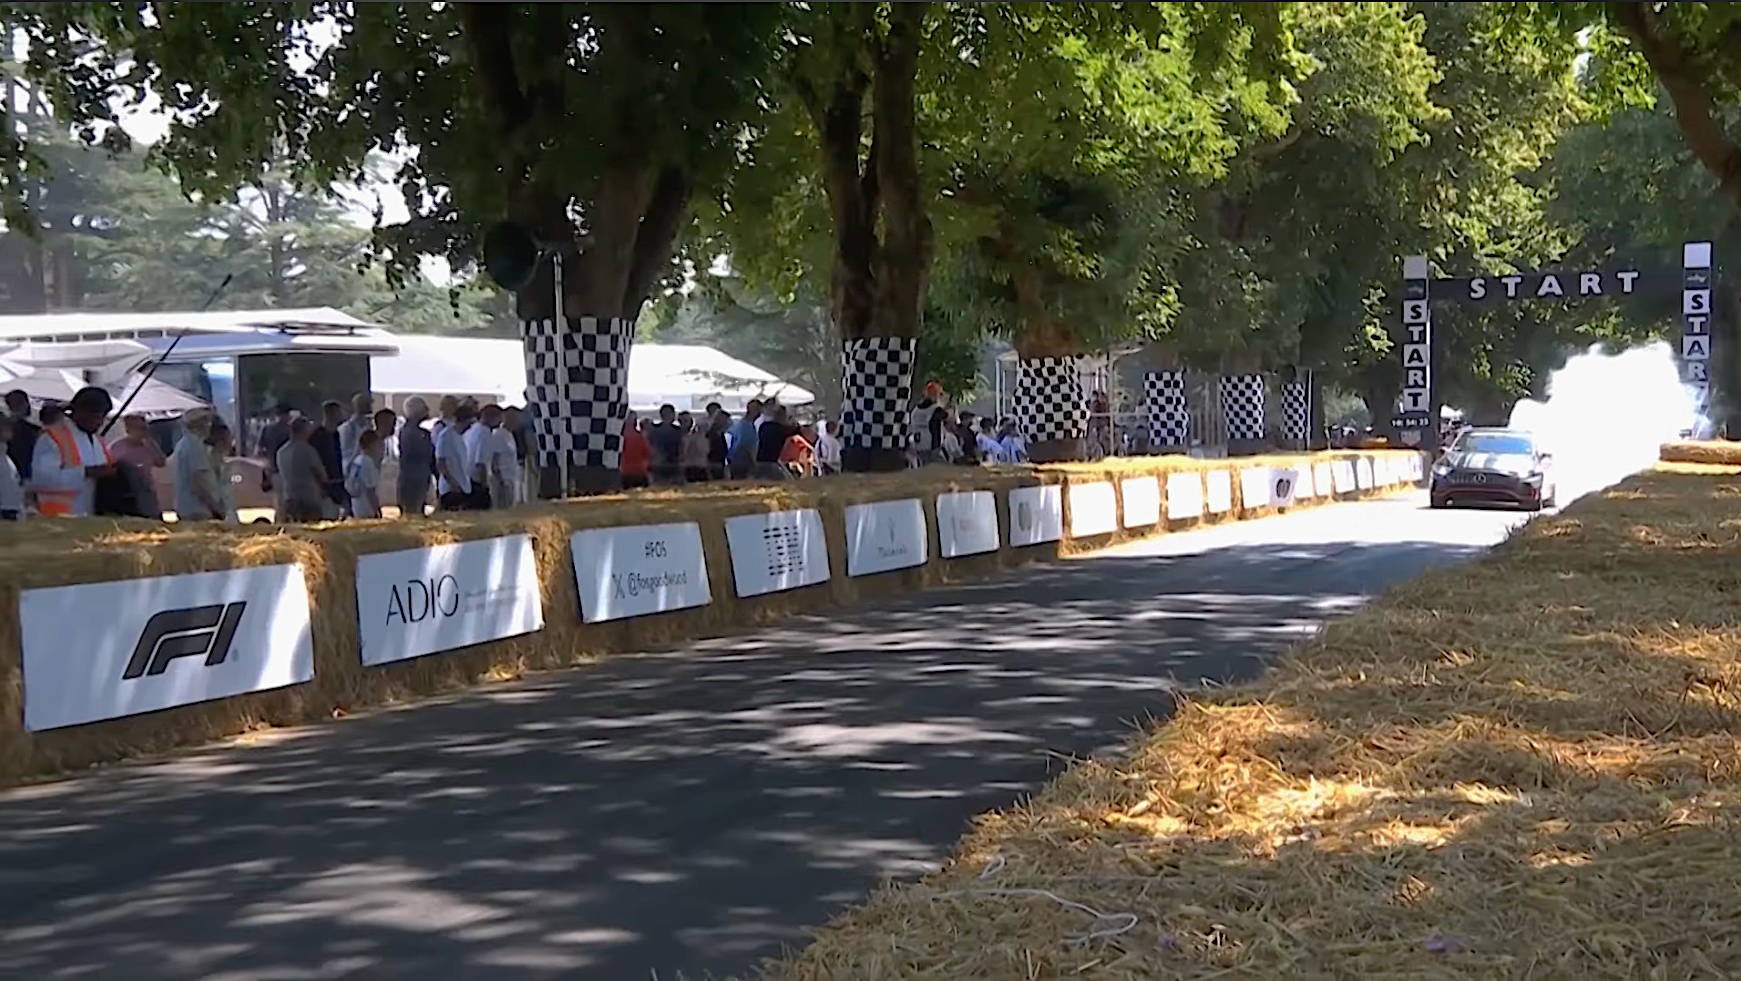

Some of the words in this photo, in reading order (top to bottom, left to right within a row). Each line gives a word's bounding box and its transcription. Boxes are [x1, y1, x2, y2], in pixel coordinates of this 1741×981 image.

[1469, 271, 1639, 298] START
[1407, 303, 1424, 408] START
[1686, 294, 1707, 404] STAR
[645, 541, 667, 558] #FOS
[386, 574, 459, 626] ADIO
[122, 601, 247, 680] F1
